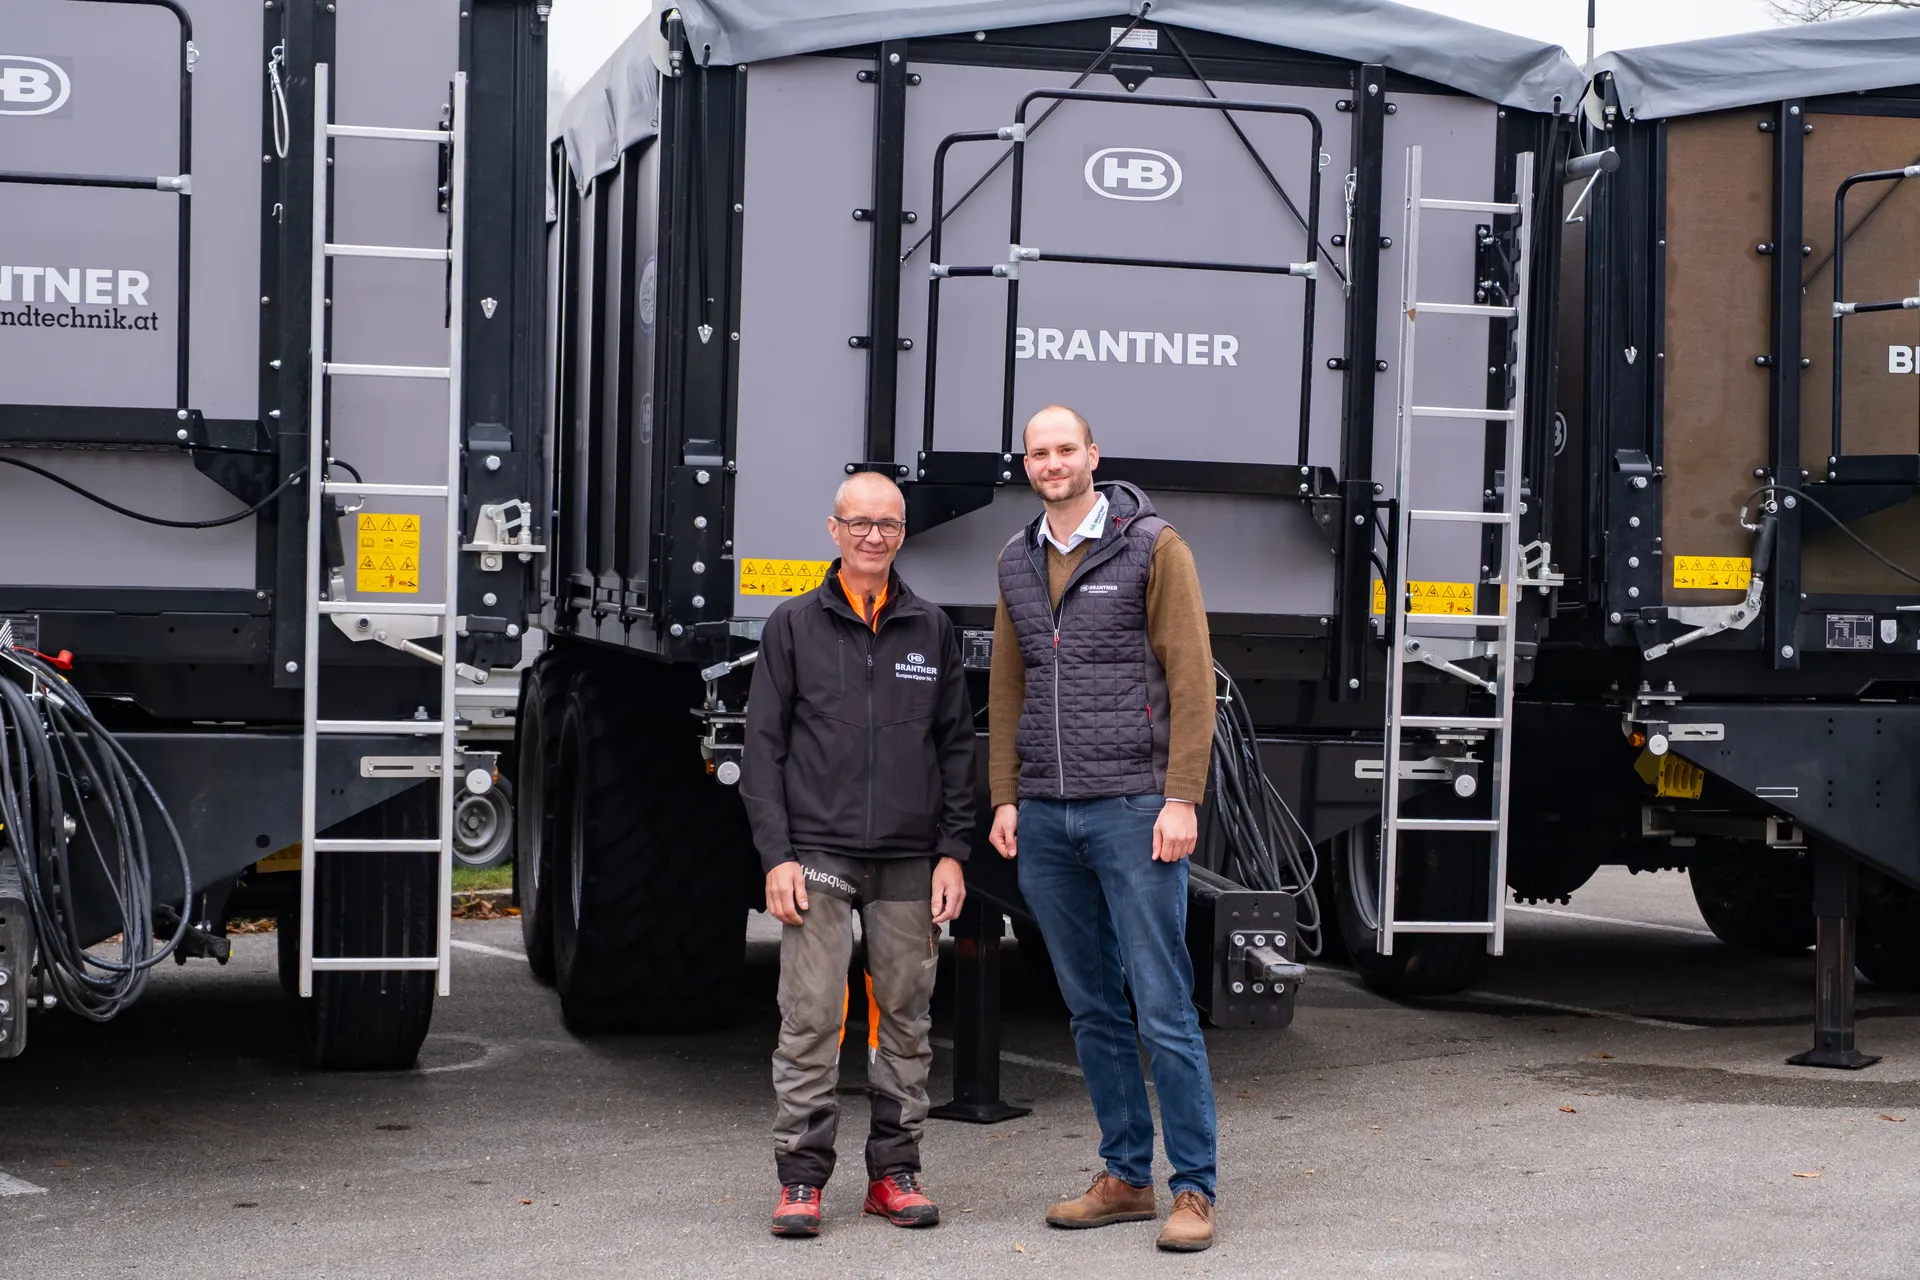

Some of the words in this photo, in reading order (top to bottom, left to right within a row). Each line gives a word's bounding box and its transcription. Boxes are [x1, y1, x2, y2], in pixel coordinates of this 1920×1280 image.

[1103, 157, 1168, 190] HB
[1015, 326, 1239, 367] BRANTNER
[1888, 345, 1920, 375] B
[895, 663, 937, 675] BRANTNER
